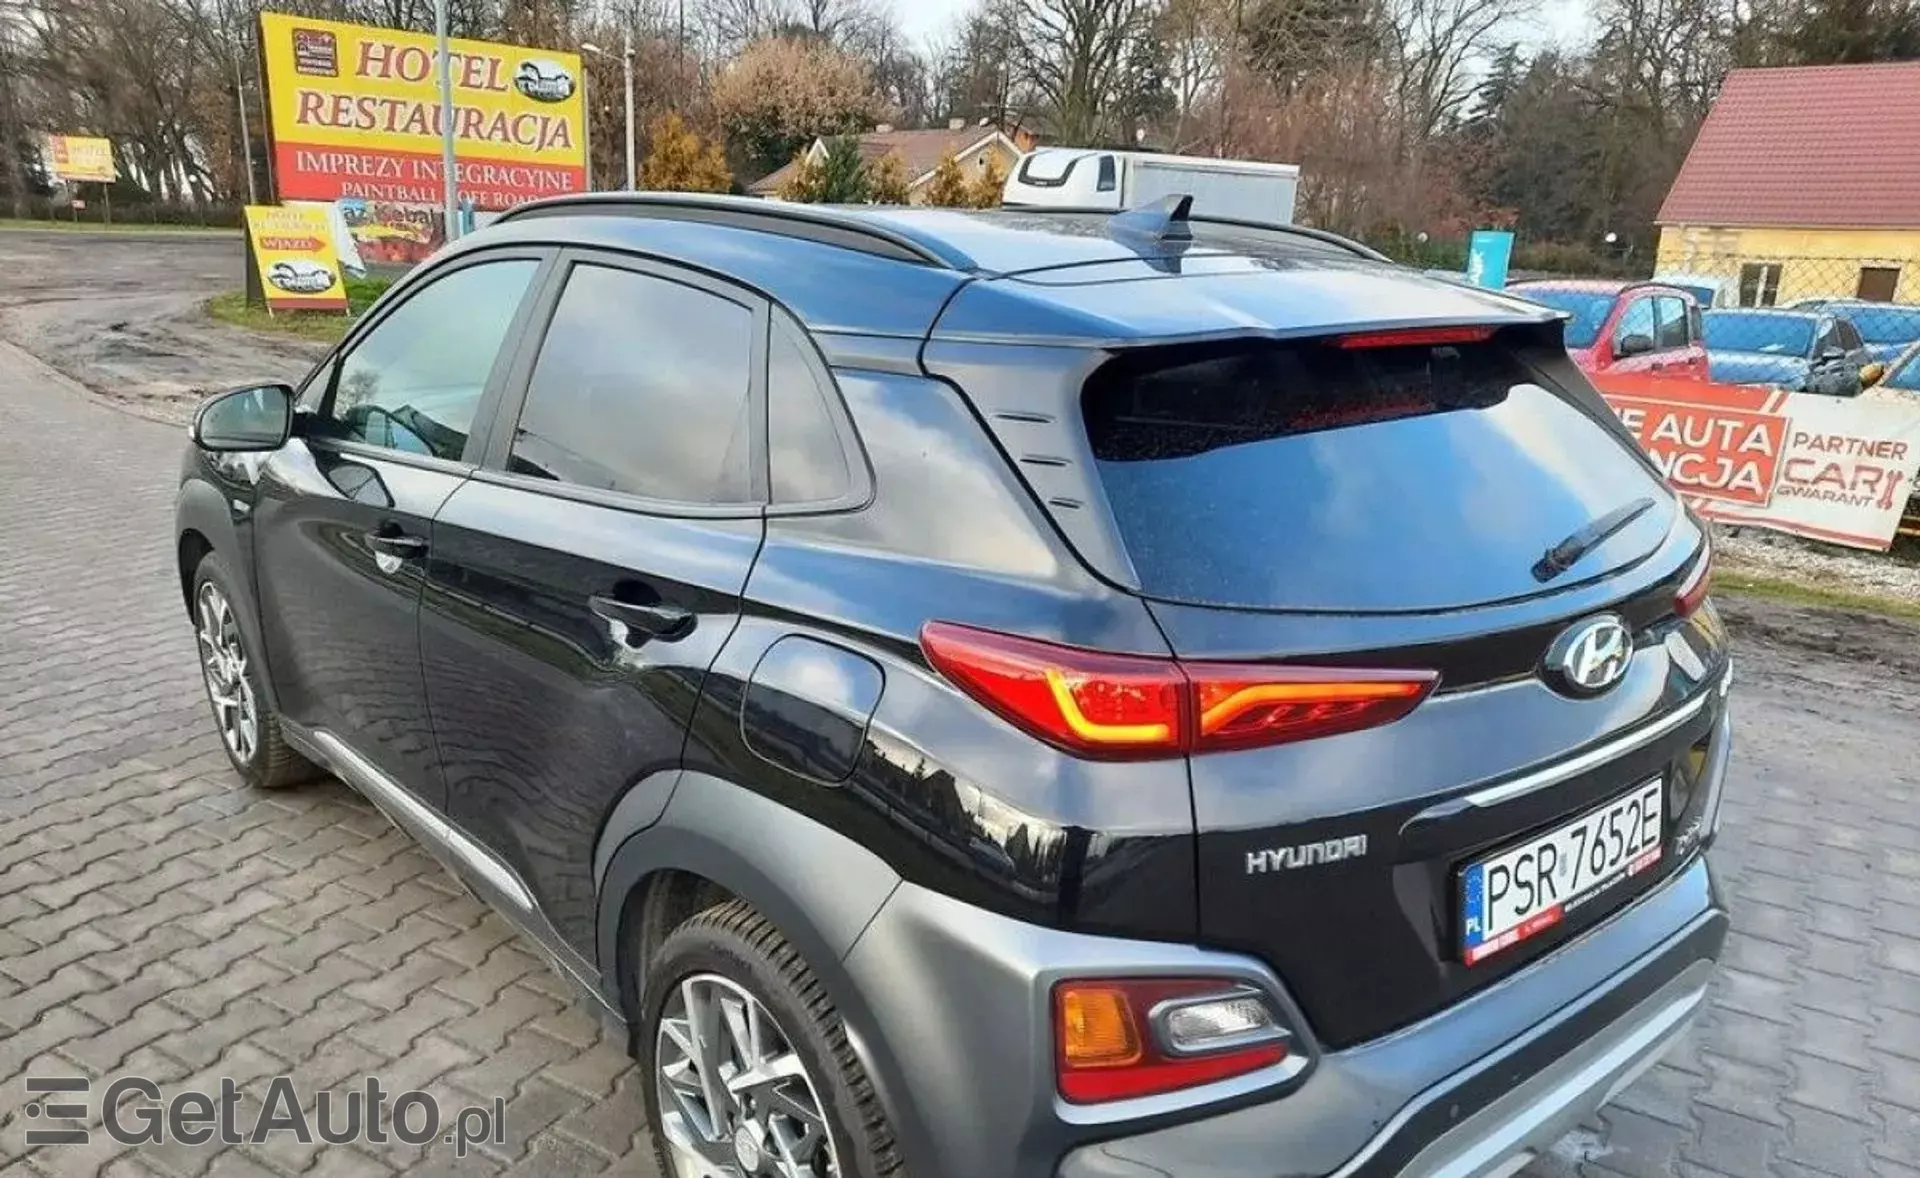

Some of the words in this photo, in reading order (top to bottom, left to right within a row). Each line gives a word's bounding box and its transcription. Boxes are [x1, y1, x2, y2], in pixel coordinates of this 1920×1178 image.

[296, 90, 572, 153] RESTAURACJA
[296, 150, 404, 178] IMPREZY
[412, 158, 574, 191] INEGRACYJNE
[341, 182, 438, 201] PAINTBALL
[1612, 406, 1647, 441] E
[1650, 412, 1773, 457] AUTA
[1792, 431, 1908, 461] PARTNER
[1776, 484, 1875, 507] GWARANT
[1783, 457, 1884, 494] CAR
[1245, 834, 1368, 875] HYUNDAI
[1487, 842, 1558, 931] PSR
[1570, 788, 1660, 890] 7652E
